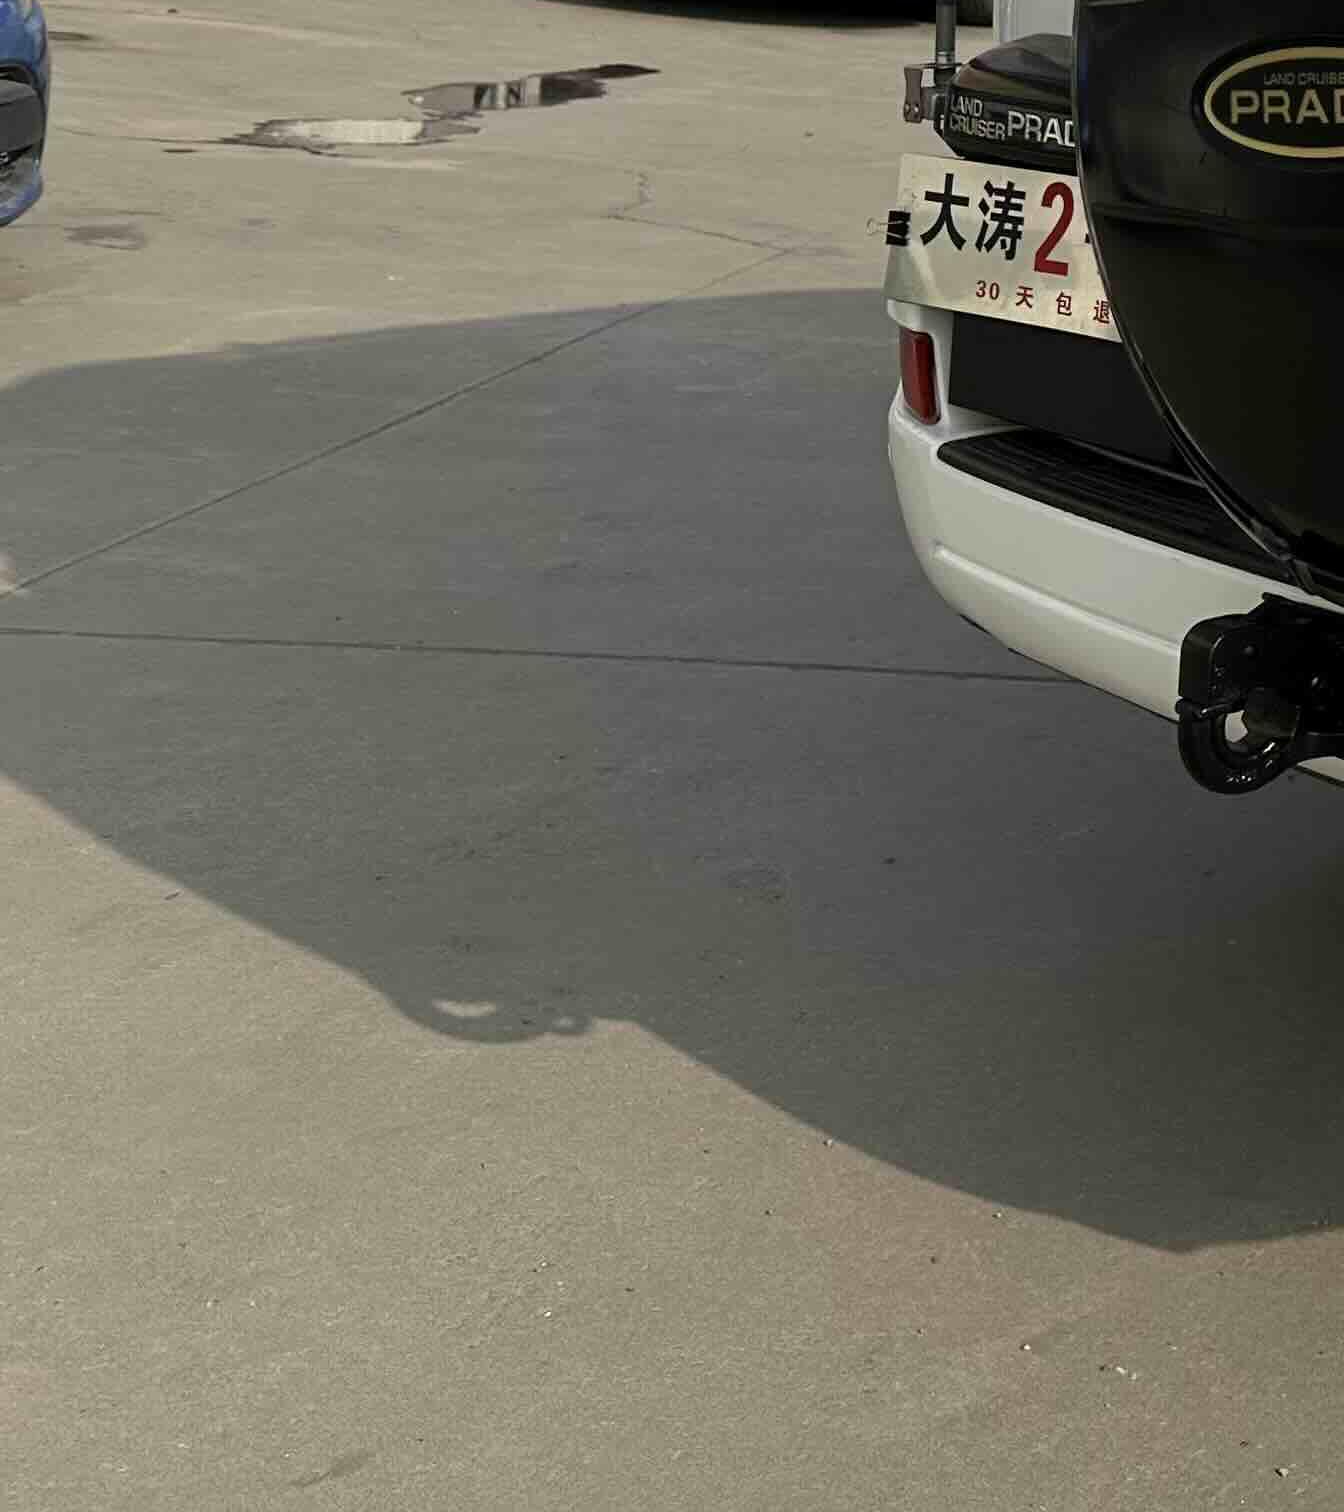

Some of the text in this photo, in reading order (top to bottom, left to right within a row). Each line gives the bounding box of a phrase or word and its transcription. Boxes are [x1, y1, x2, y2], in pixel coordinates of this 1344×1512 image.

[1264, 71, 1296, 86] LAND
[950, 95, 983, 117] LAND
[949, 117, 1007, 141] CRUISER
[920, 173, 1093, 278] 大涛2
